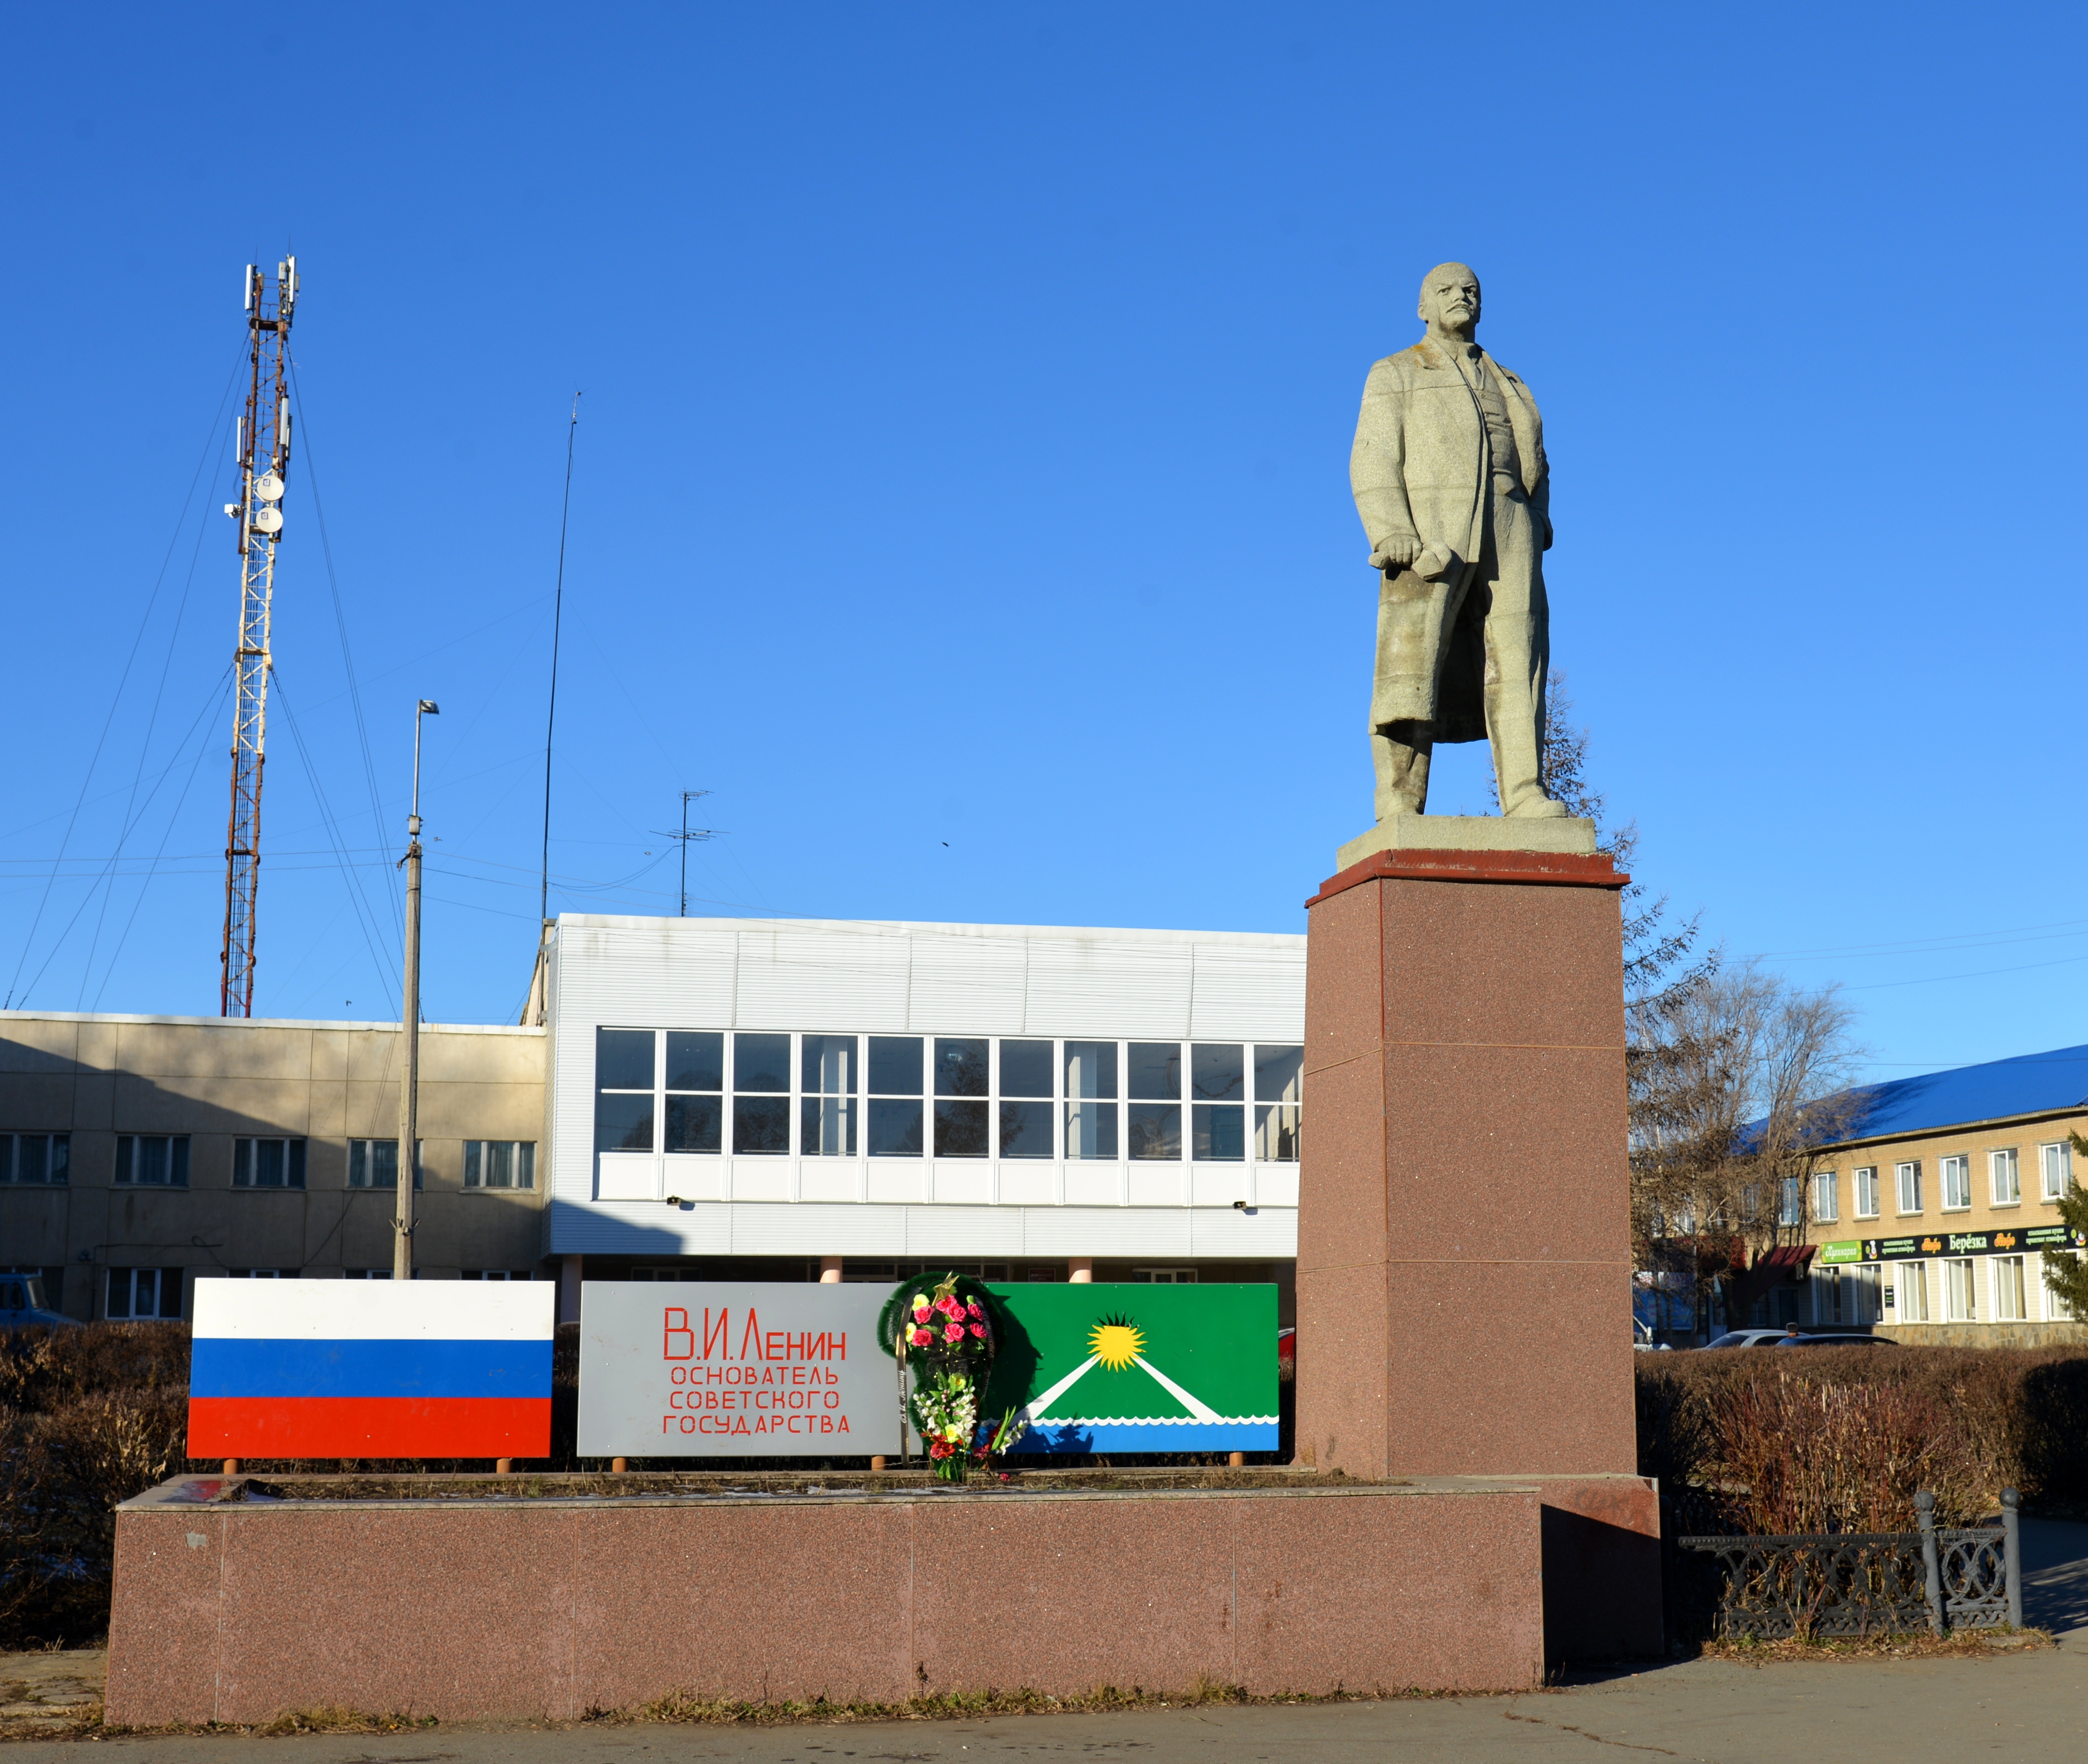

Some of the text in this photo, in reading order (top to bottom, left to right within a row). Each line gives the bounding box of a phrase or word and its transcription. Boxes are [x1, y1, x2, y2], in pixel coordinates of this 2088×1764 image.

[1825, 1245, 1857, 1260] Кулинария
[671, 1367, 839, 1385] ОСНОВАТЕЛЬ
[670, 1391, 840, 1410] СОВЕТСКОГО
[663, 1415, 850, 1436] ГОСУДАРСТВА
